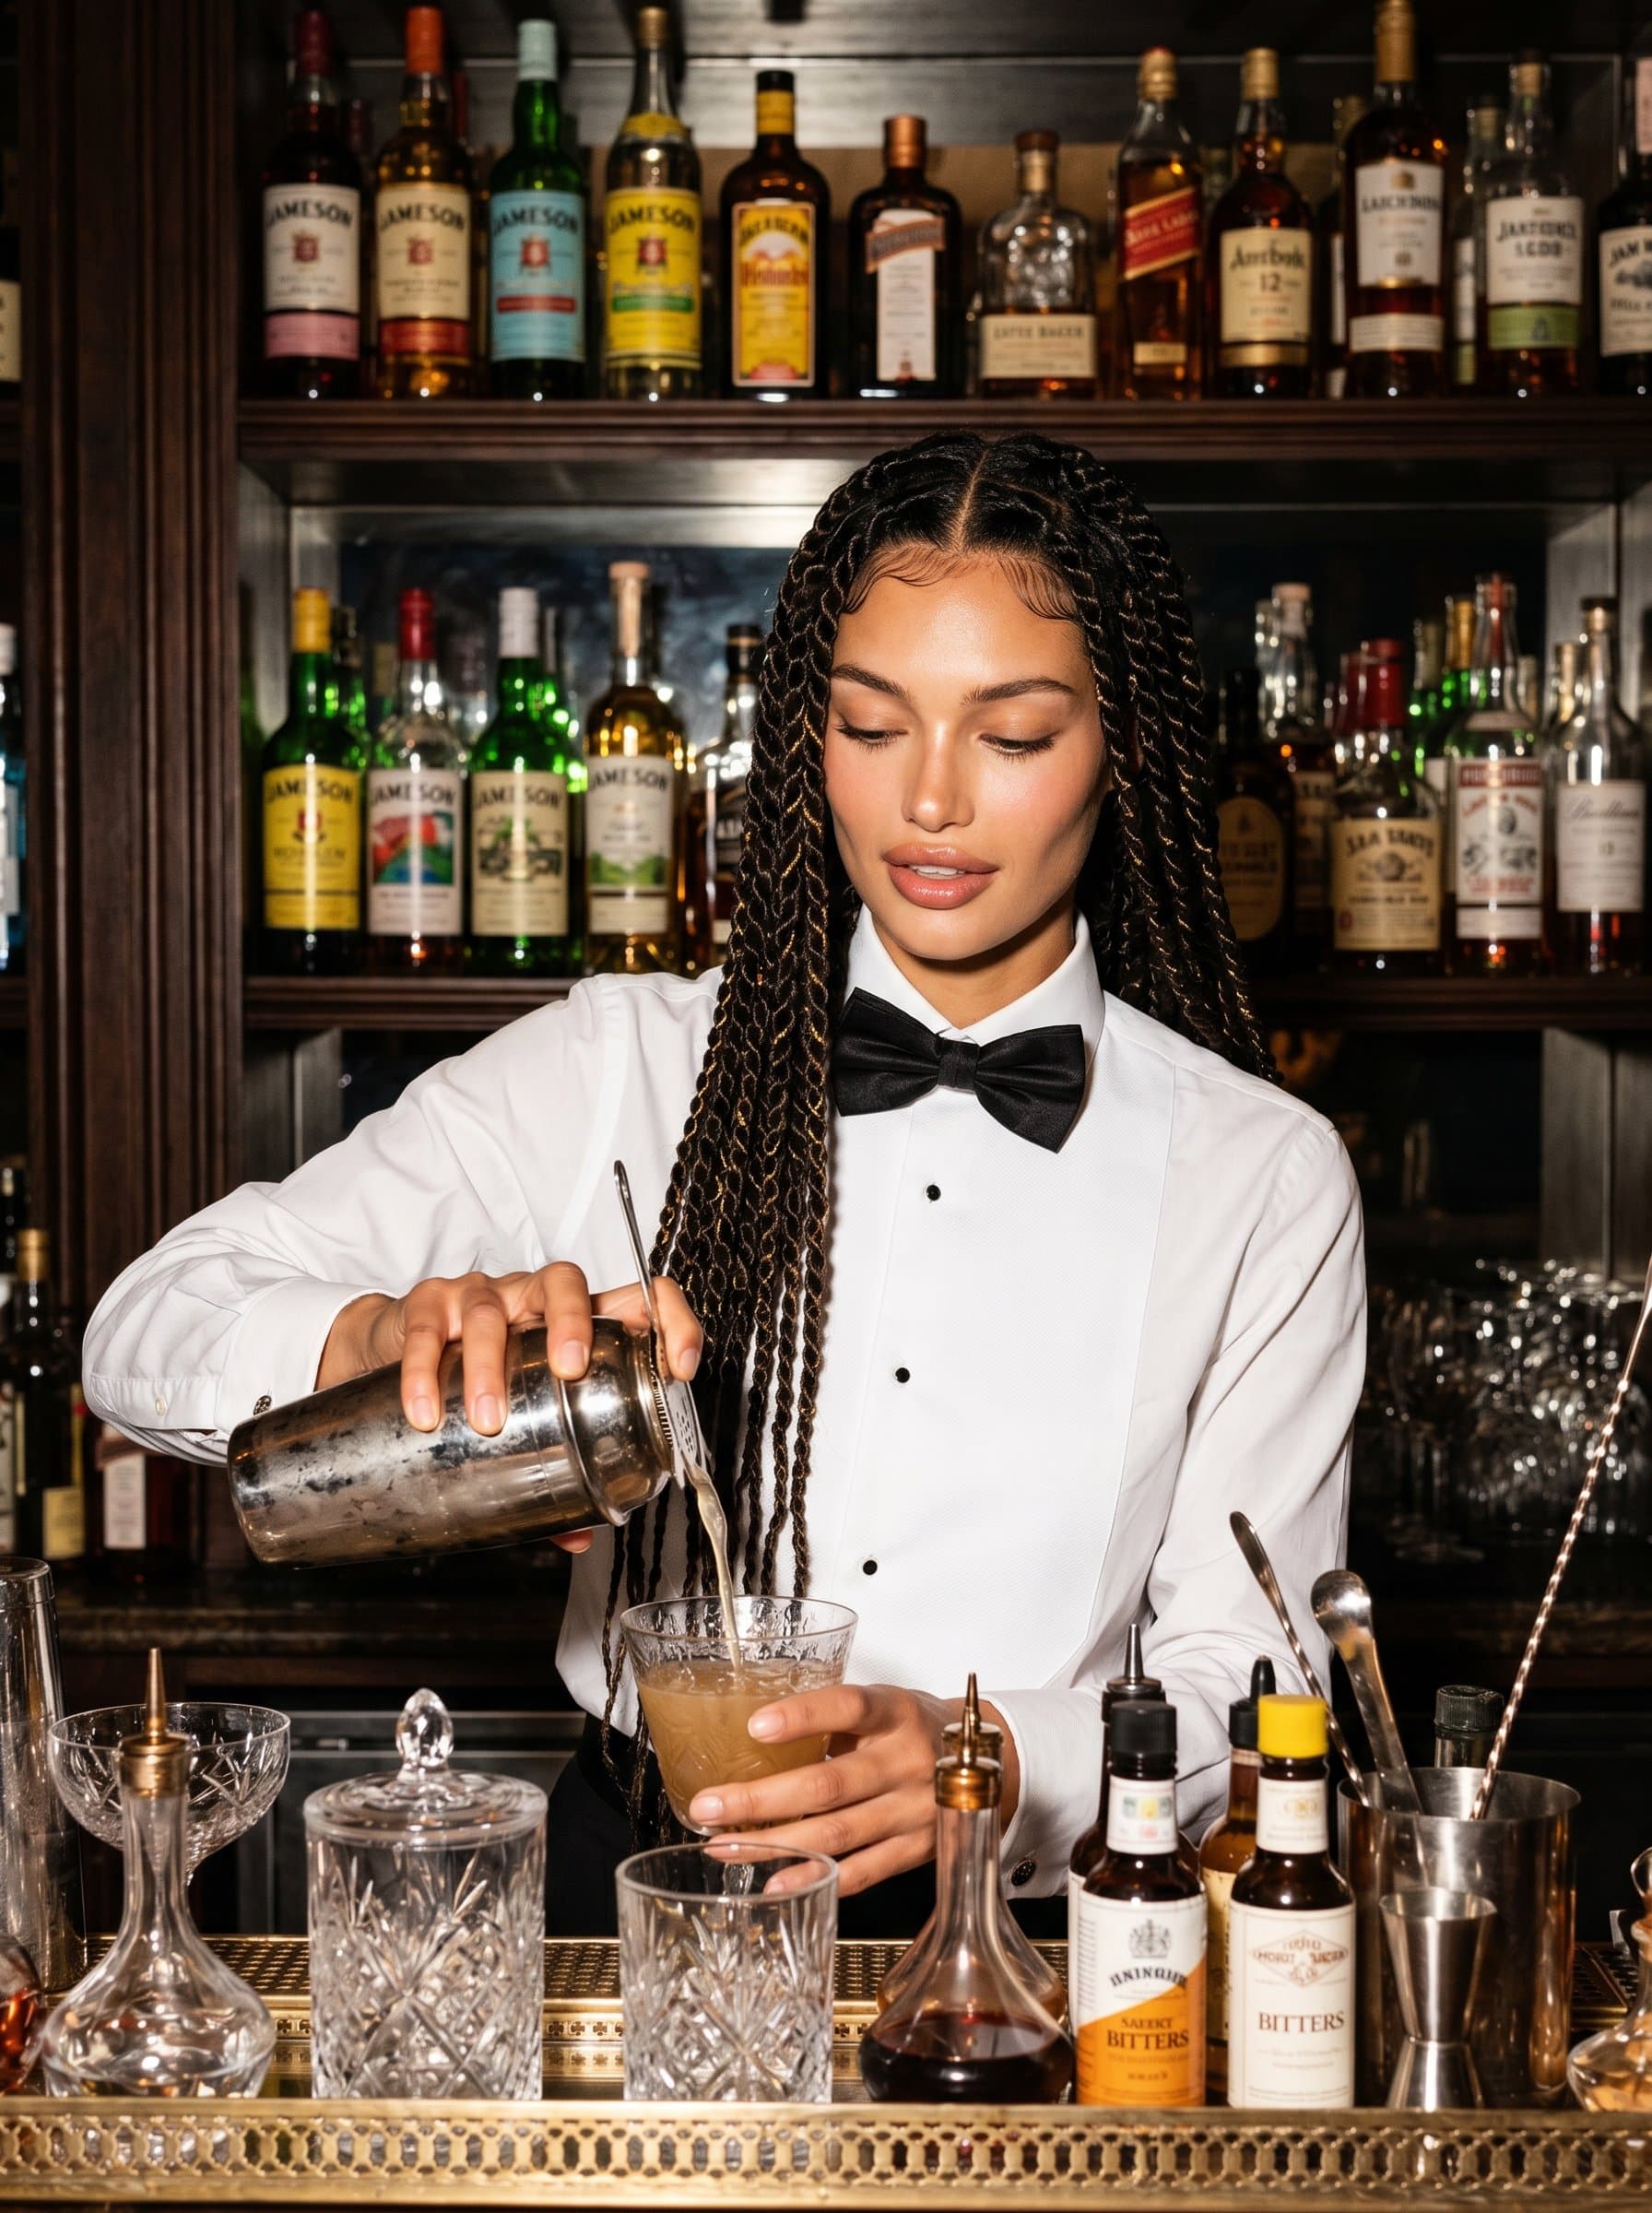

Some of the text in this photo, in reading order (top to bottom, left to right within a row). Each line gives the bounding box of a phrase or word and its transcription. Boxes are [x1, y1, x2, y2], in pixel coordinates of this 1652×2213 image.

[266, 200, 352, 231] JAMESON
[379, 203, 465, 231] JAMESON
[494, 206, 578, 233] JAMESON
[609, 206, 695, 234] JAMESON
[1259, 273, 1281, 293] 12
[1258, 2011, 1346, 2033] BITTERS
[1106, 2029, 1189, 2050] BITTERS
